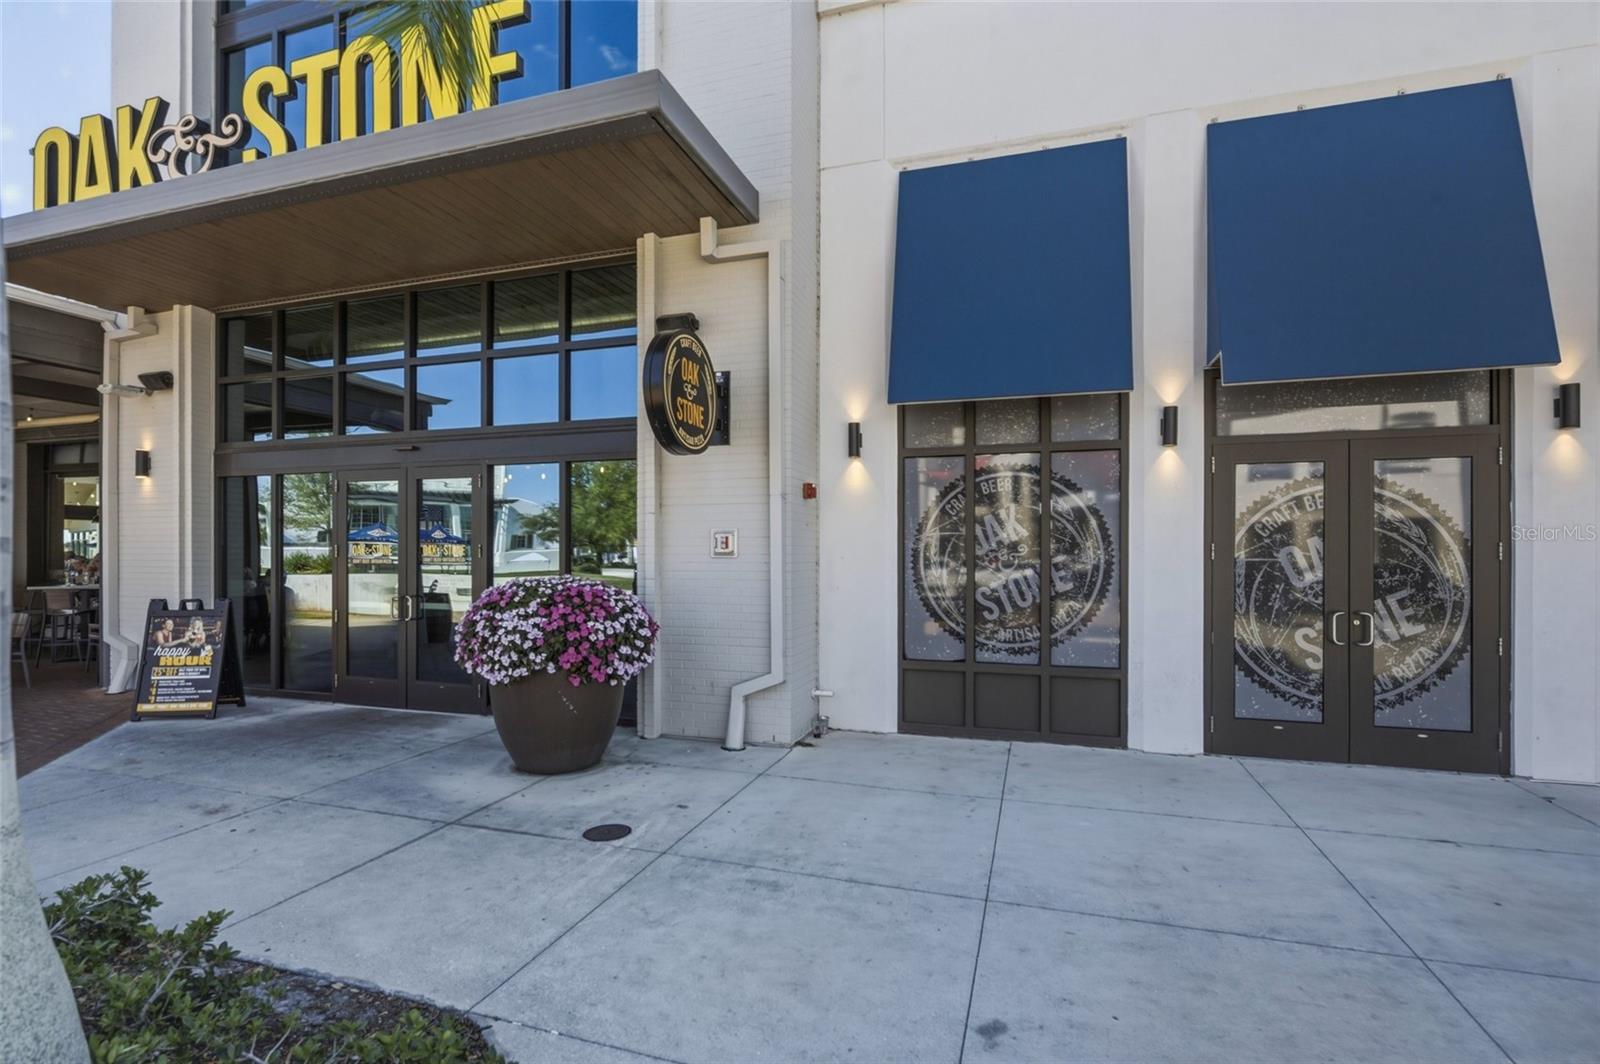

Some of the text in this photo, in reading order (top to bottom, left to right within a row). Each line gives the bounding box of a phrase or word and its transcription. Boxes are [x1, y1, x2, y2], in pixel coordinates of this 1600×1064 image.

[32, 0, 530, 211] OAK & STONE
[681, 356, 700, 388] OAK
[676, 397, 705, 429] STONE
[981, 478, 1012, 495] BEER
[1254, 493, 1324, 538] CRAFT BE
[997, 623, 1041, 642] ARTISA
[154, 645, 191, 658] happy
[159, 655, 212, 666] HOUR
